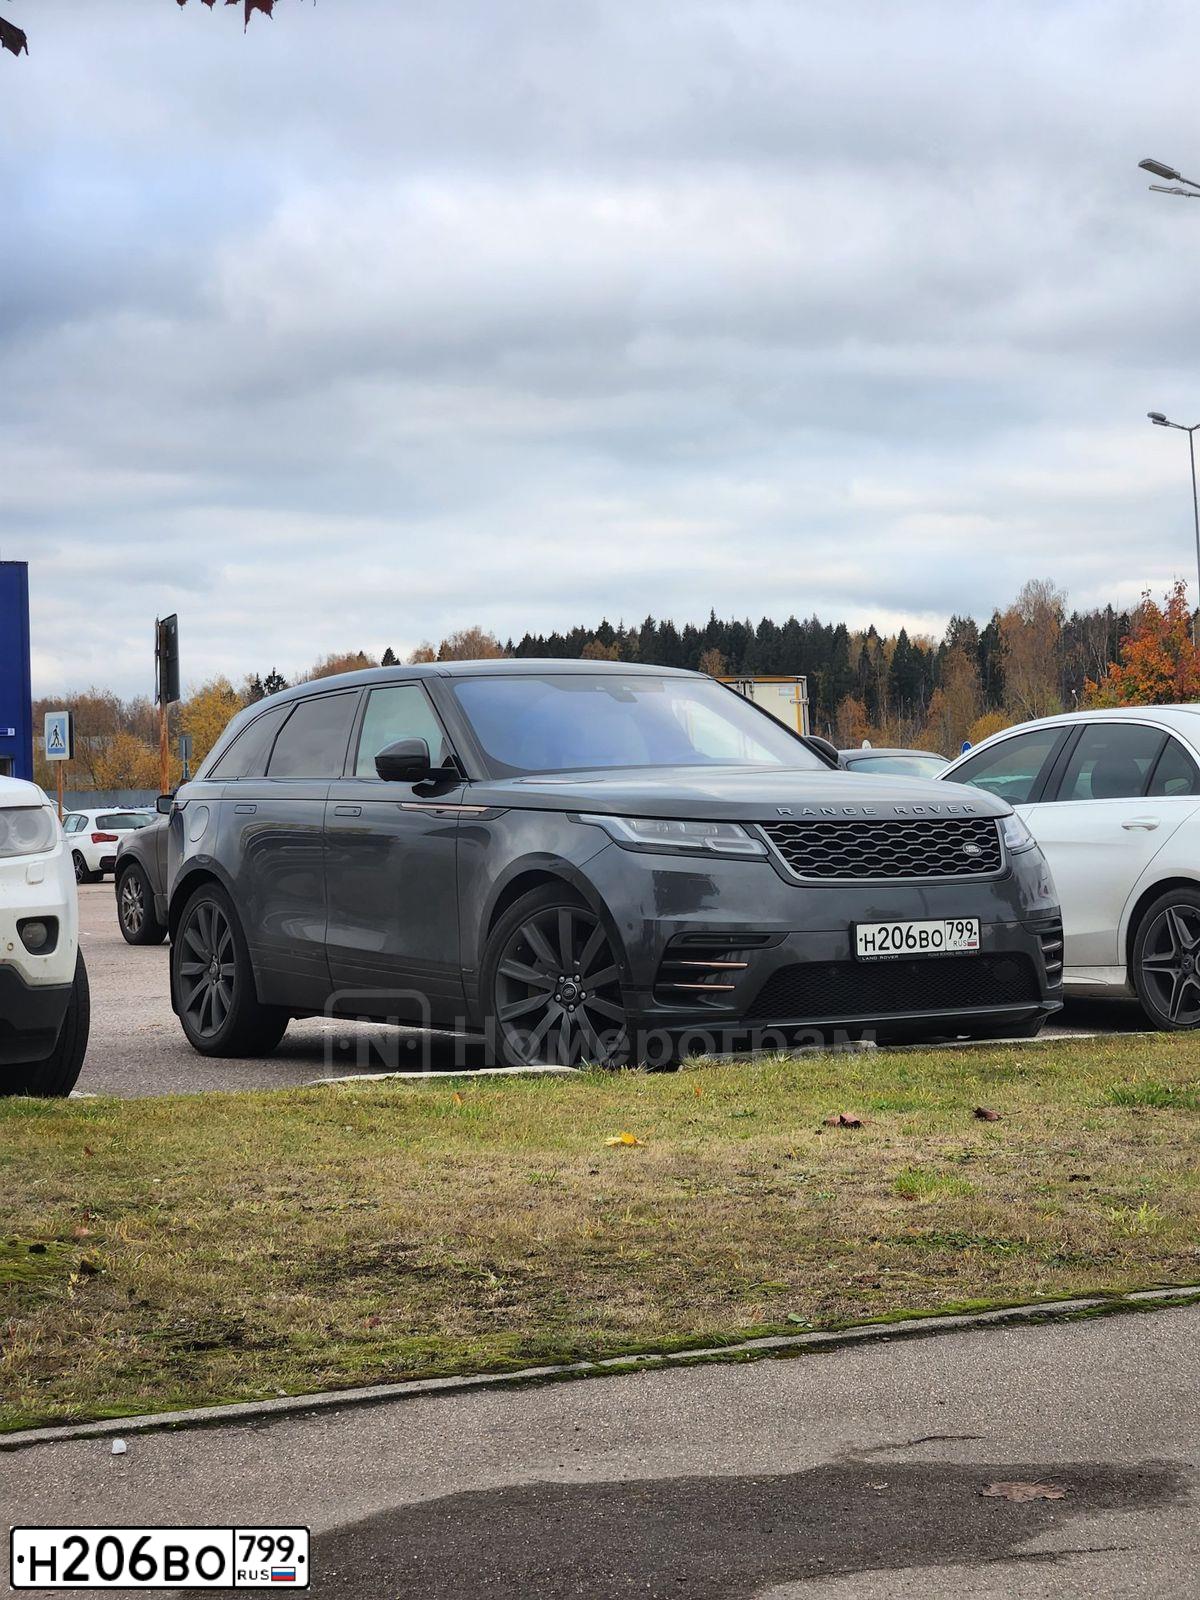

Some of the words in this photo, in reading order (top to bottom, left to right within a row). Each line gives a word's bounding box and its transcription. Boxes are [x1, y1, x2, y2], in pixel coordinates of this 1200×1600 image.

[776, 806, 877, 816] RANGE
[893, 804, 976, 815] ROVER
[946, 921, 974, 940] 799
